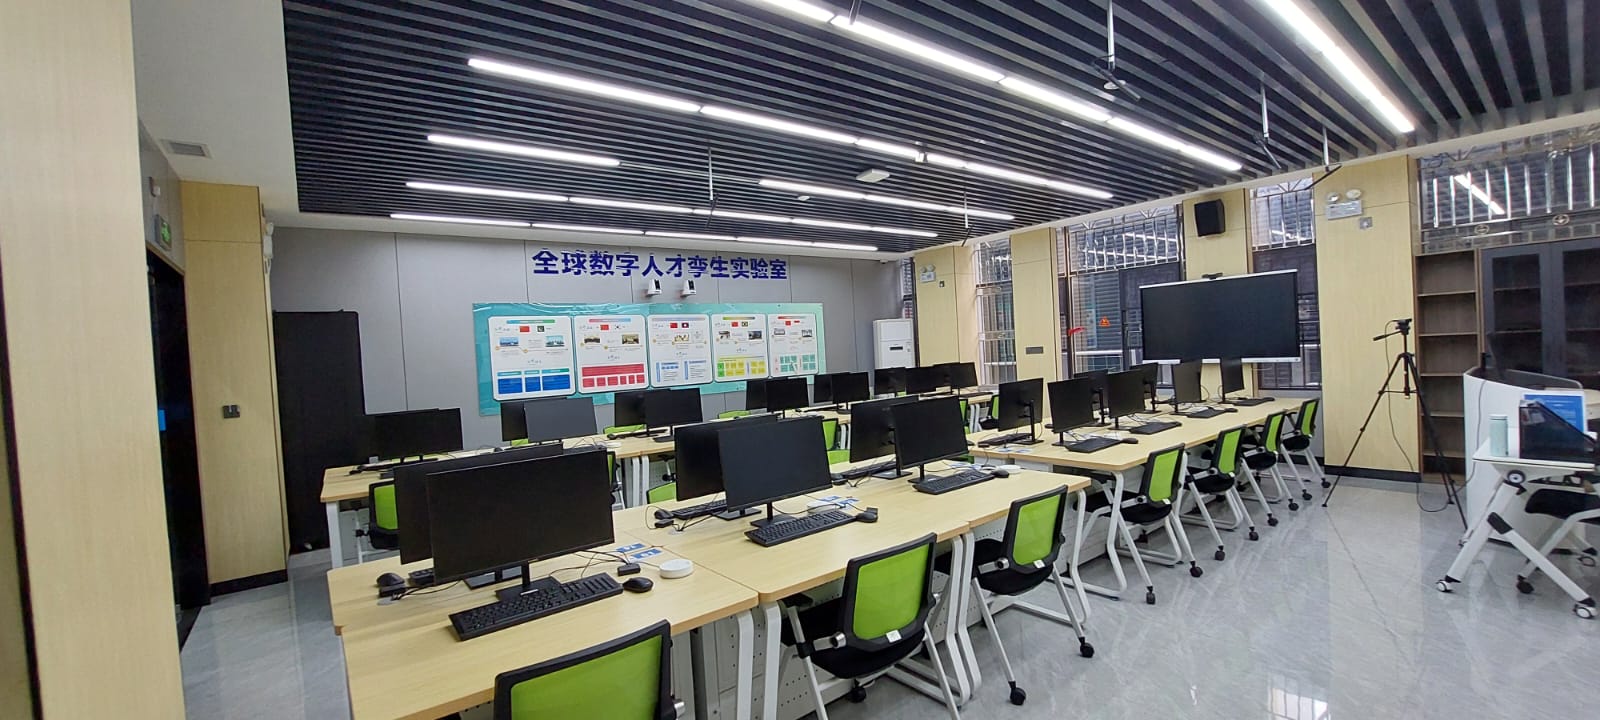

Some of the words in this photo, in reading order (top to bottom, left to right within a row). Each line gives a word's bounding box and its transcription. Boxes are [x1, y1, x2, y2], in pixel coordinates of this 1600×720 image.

[532, 248, 788, 280] 全球数字人才孪生实验室
